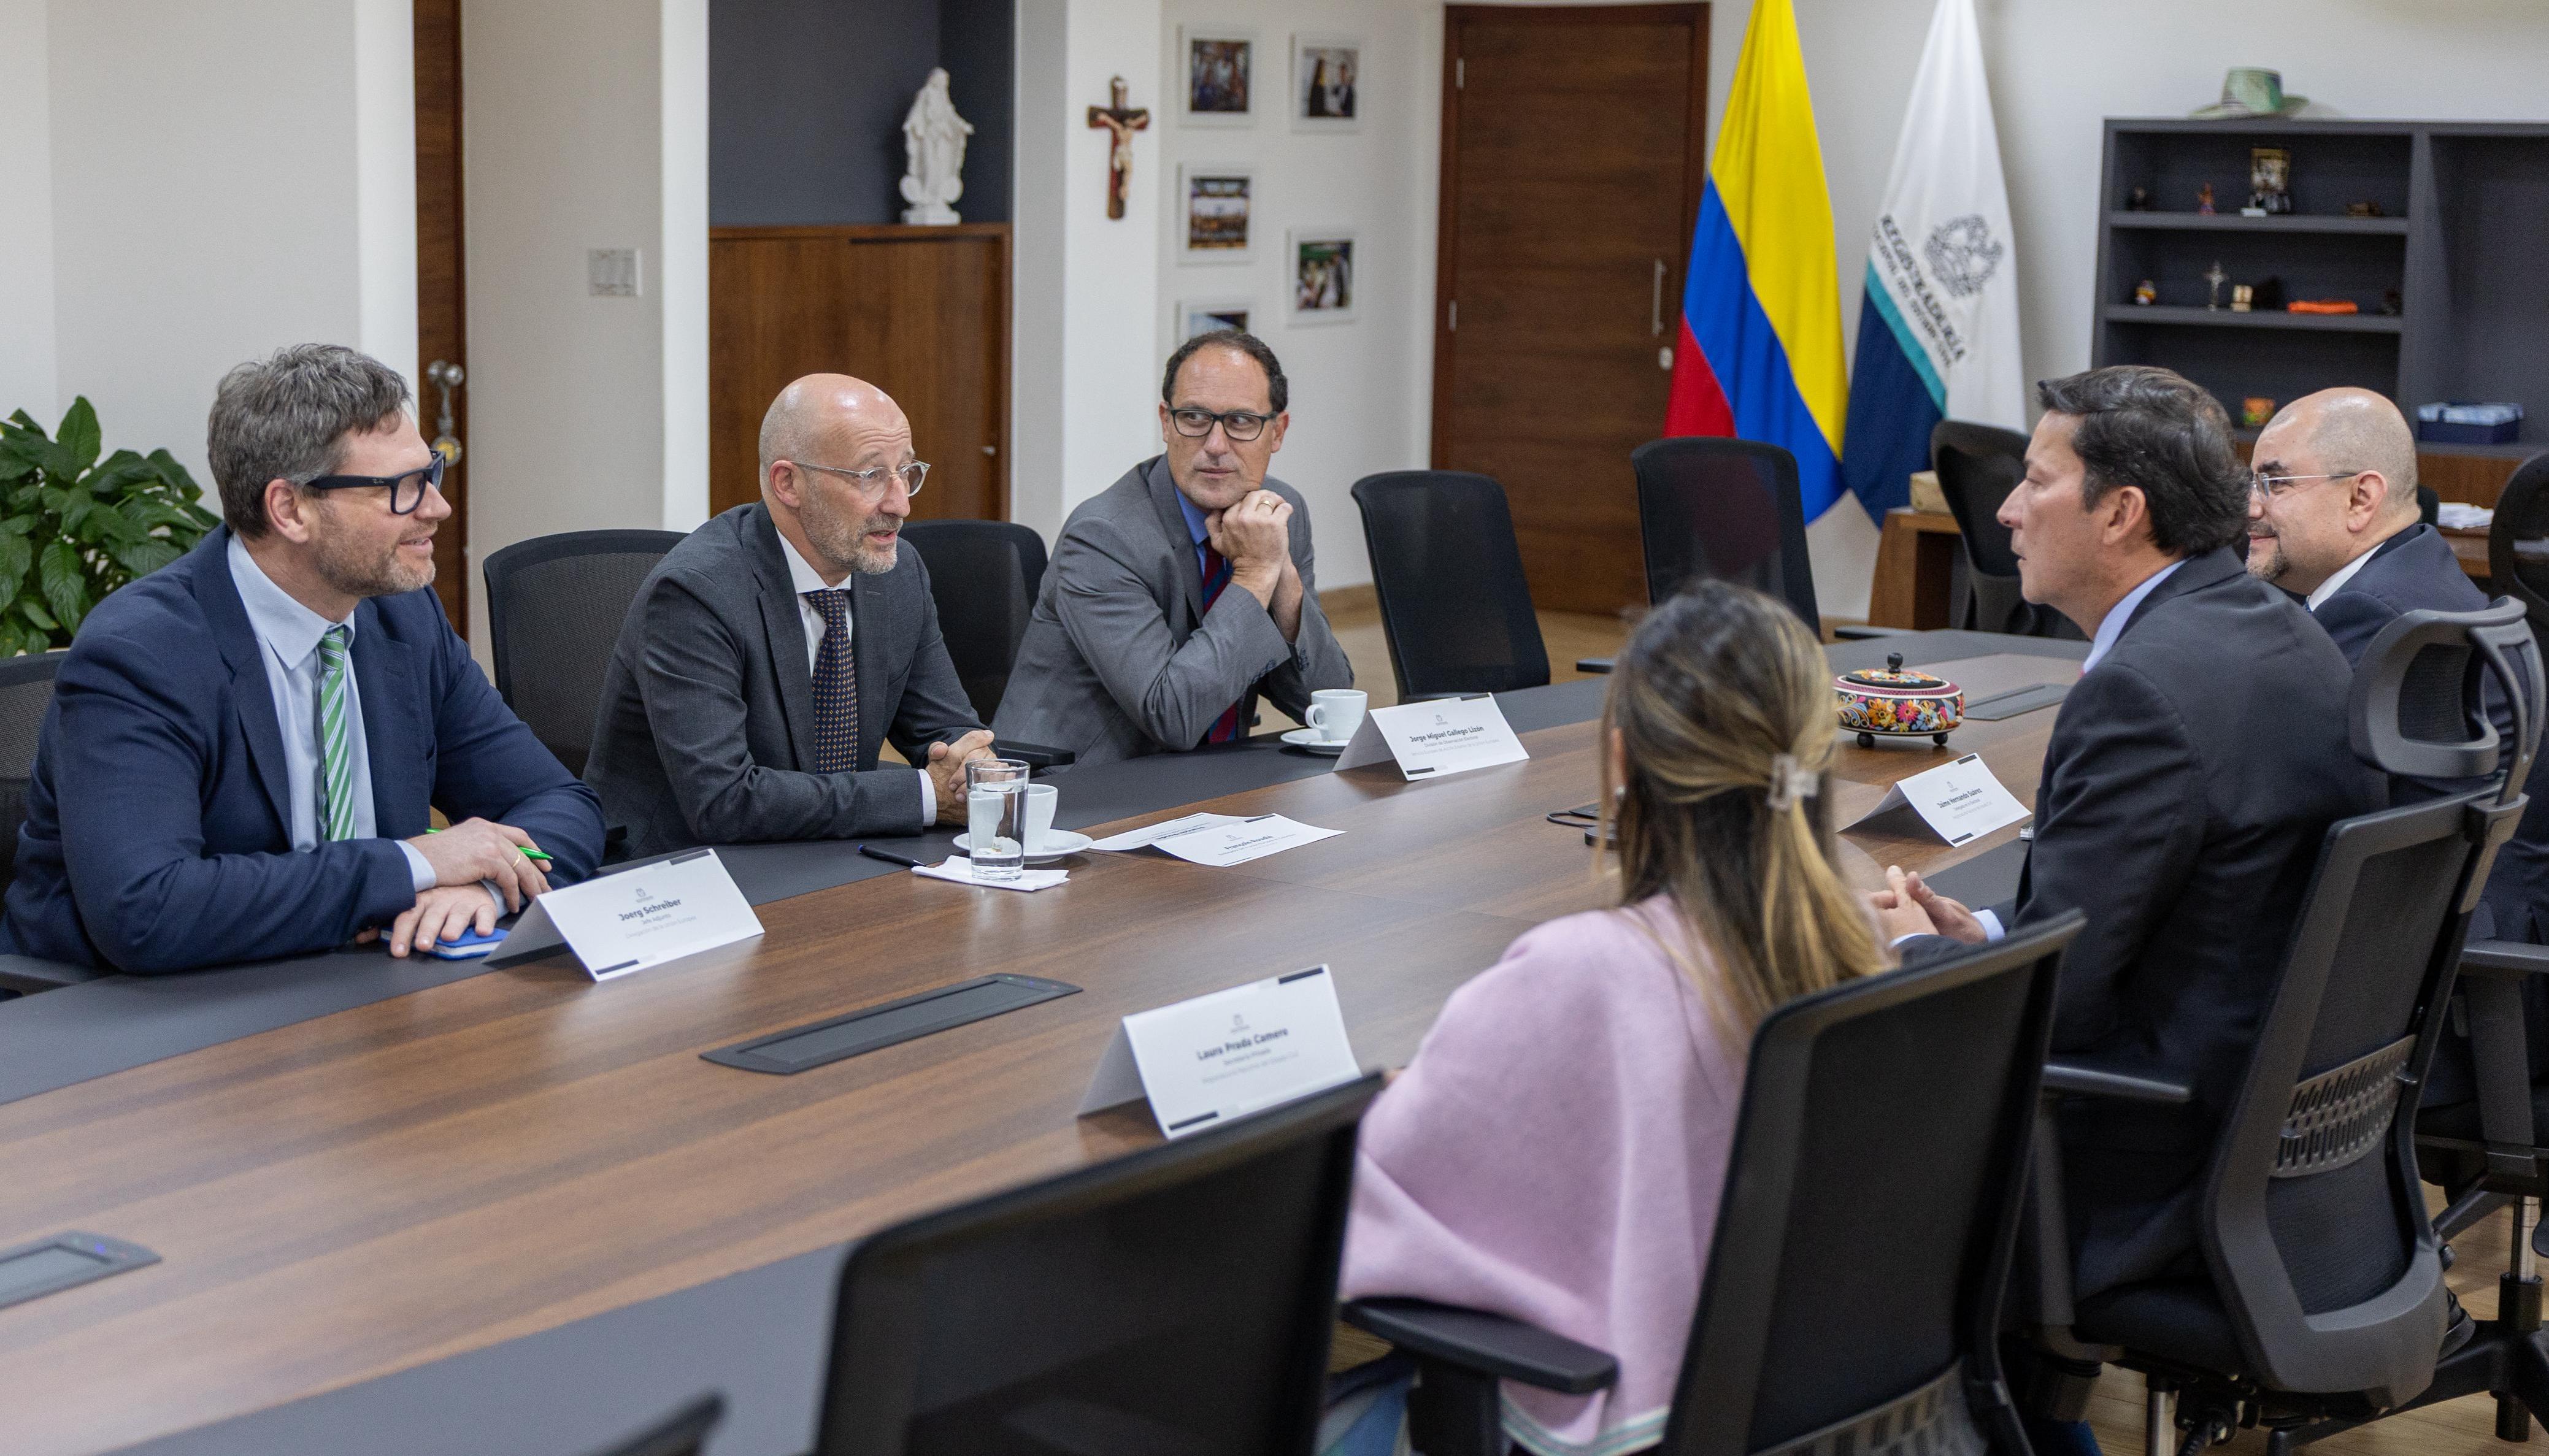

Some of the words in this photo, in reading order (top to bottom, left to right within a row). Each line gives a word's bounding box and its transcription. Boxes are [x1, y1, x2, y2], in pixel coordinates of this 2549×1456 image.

[1426, 731, 1447, 740] Miguel
[1948, 793, 1969, 804] Hernando
[618, 910, 644, 921] Joerg
[643, 899, 682, 914] Schreiber
[1197, 1046, 1223, 1061] Laura
[1225, 1038, 1252, 1051] Prada
